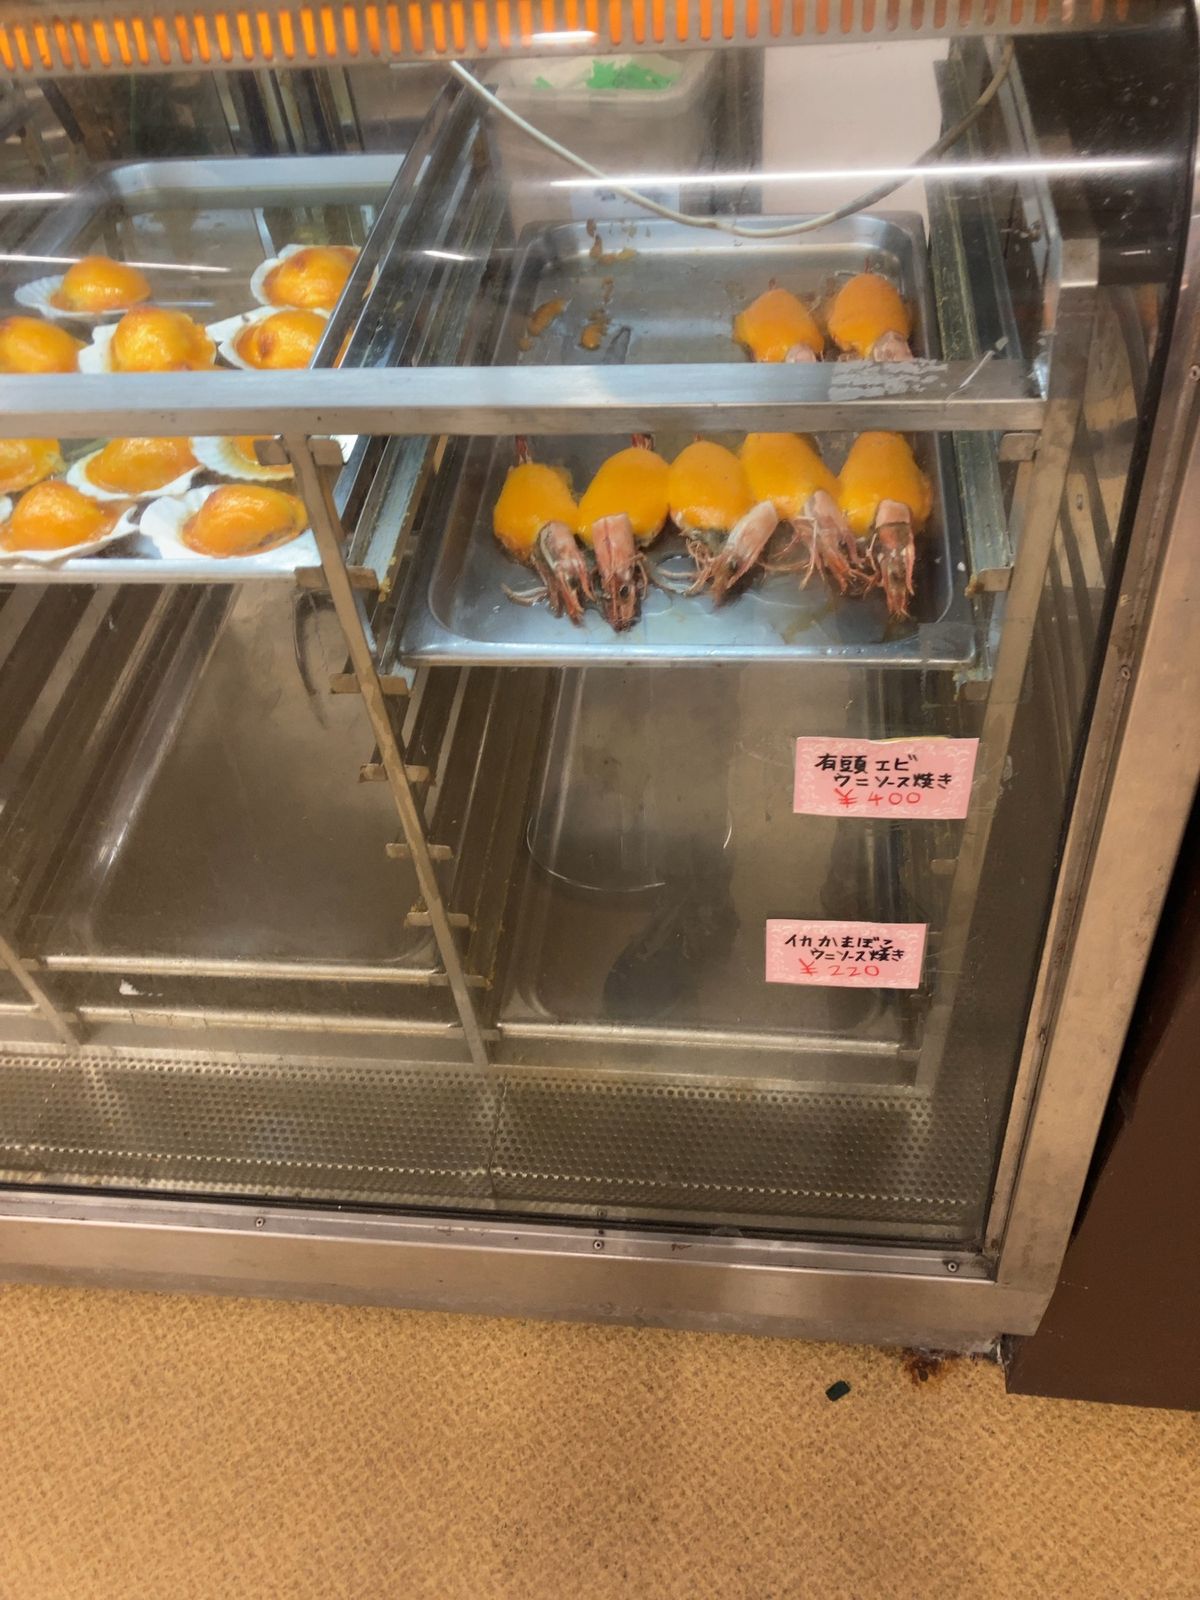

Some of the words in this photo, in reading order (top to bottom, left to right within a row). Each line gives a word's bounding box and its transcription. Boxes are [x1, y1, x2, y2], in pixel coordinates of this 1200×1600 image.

[814, 752, 918, 774] 有頭エビ
[833, 772, 952, 789] ウニソース焼き
[810, 947, 905, 962] ウニソース焼き
